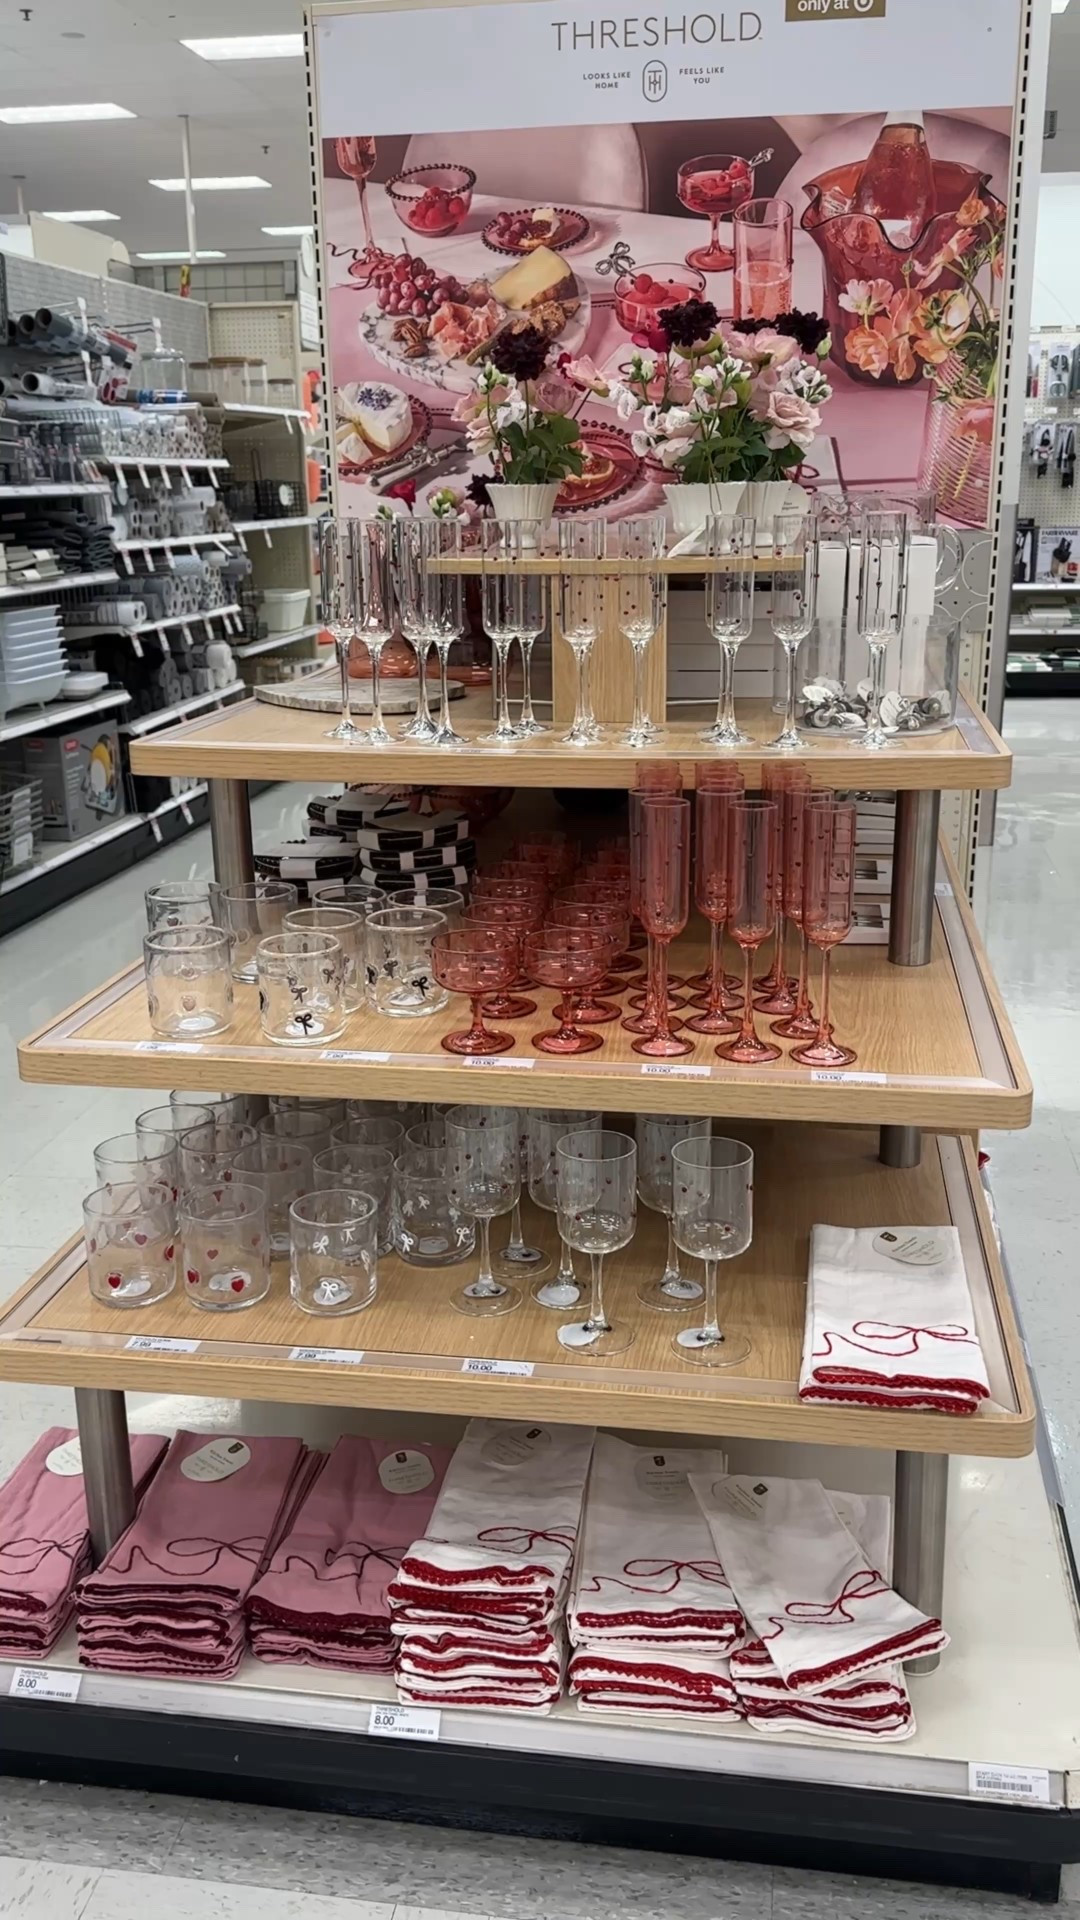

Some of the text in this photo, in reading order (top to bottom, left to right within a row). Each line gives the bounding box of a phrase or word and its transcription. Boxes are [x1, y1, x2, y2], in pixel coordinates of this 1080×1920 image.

[797, 0, 830, 13] only
[551, 12, 762, 51] THRESHOLD
[582, 71, 631, 80] LOOKS LIKE
[679, 66, 725, 76] FEELS LIKE
[595, 81, 619, 89] HOME
[17, 1677, 37, 1689] 8.00
[374, 1714, 395, 1727] 8.00
